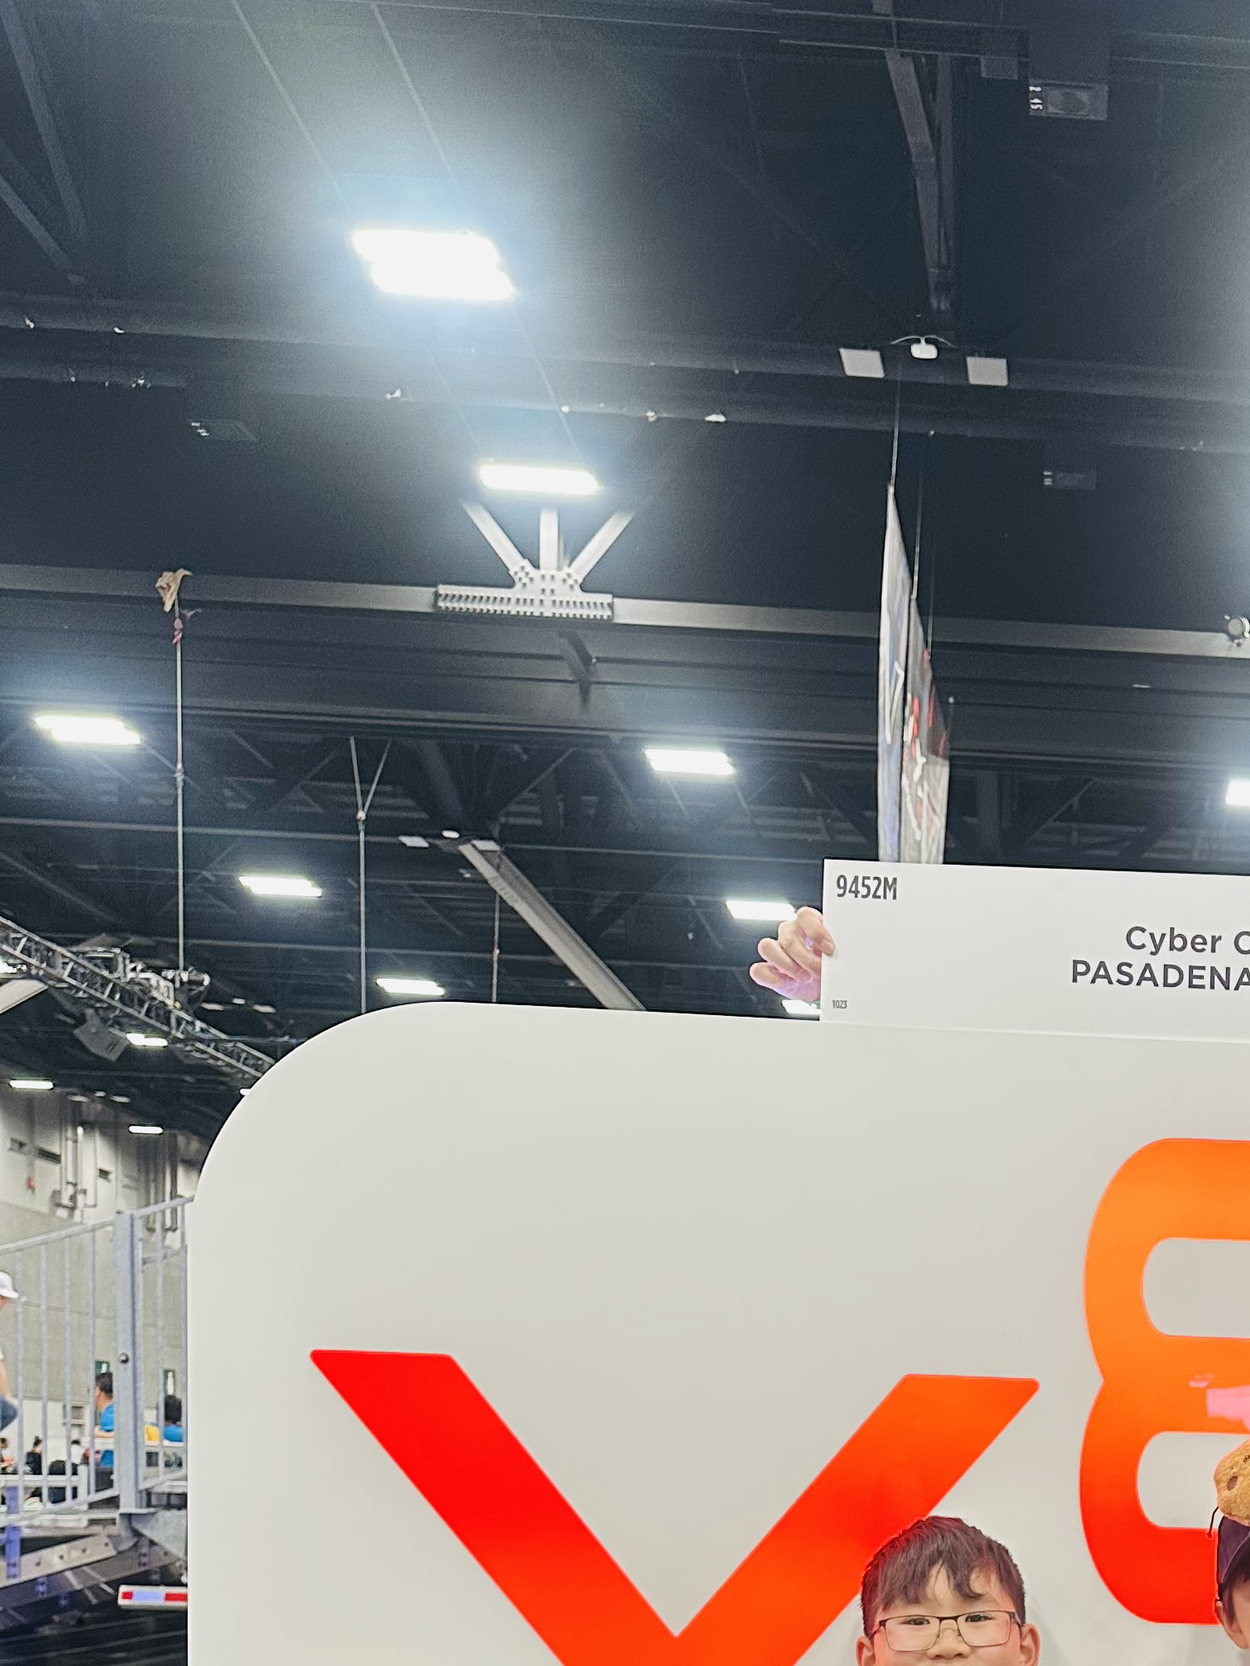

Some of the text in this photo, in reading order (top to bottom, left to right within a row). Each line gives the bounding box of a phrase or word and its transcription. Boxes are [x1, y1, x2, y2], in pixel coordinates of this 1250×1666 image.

[836, 874, 898, 900] 9452M
[1126, 926, 1222, 956] Cyber
[832, 999, 847, 1009] 1023
